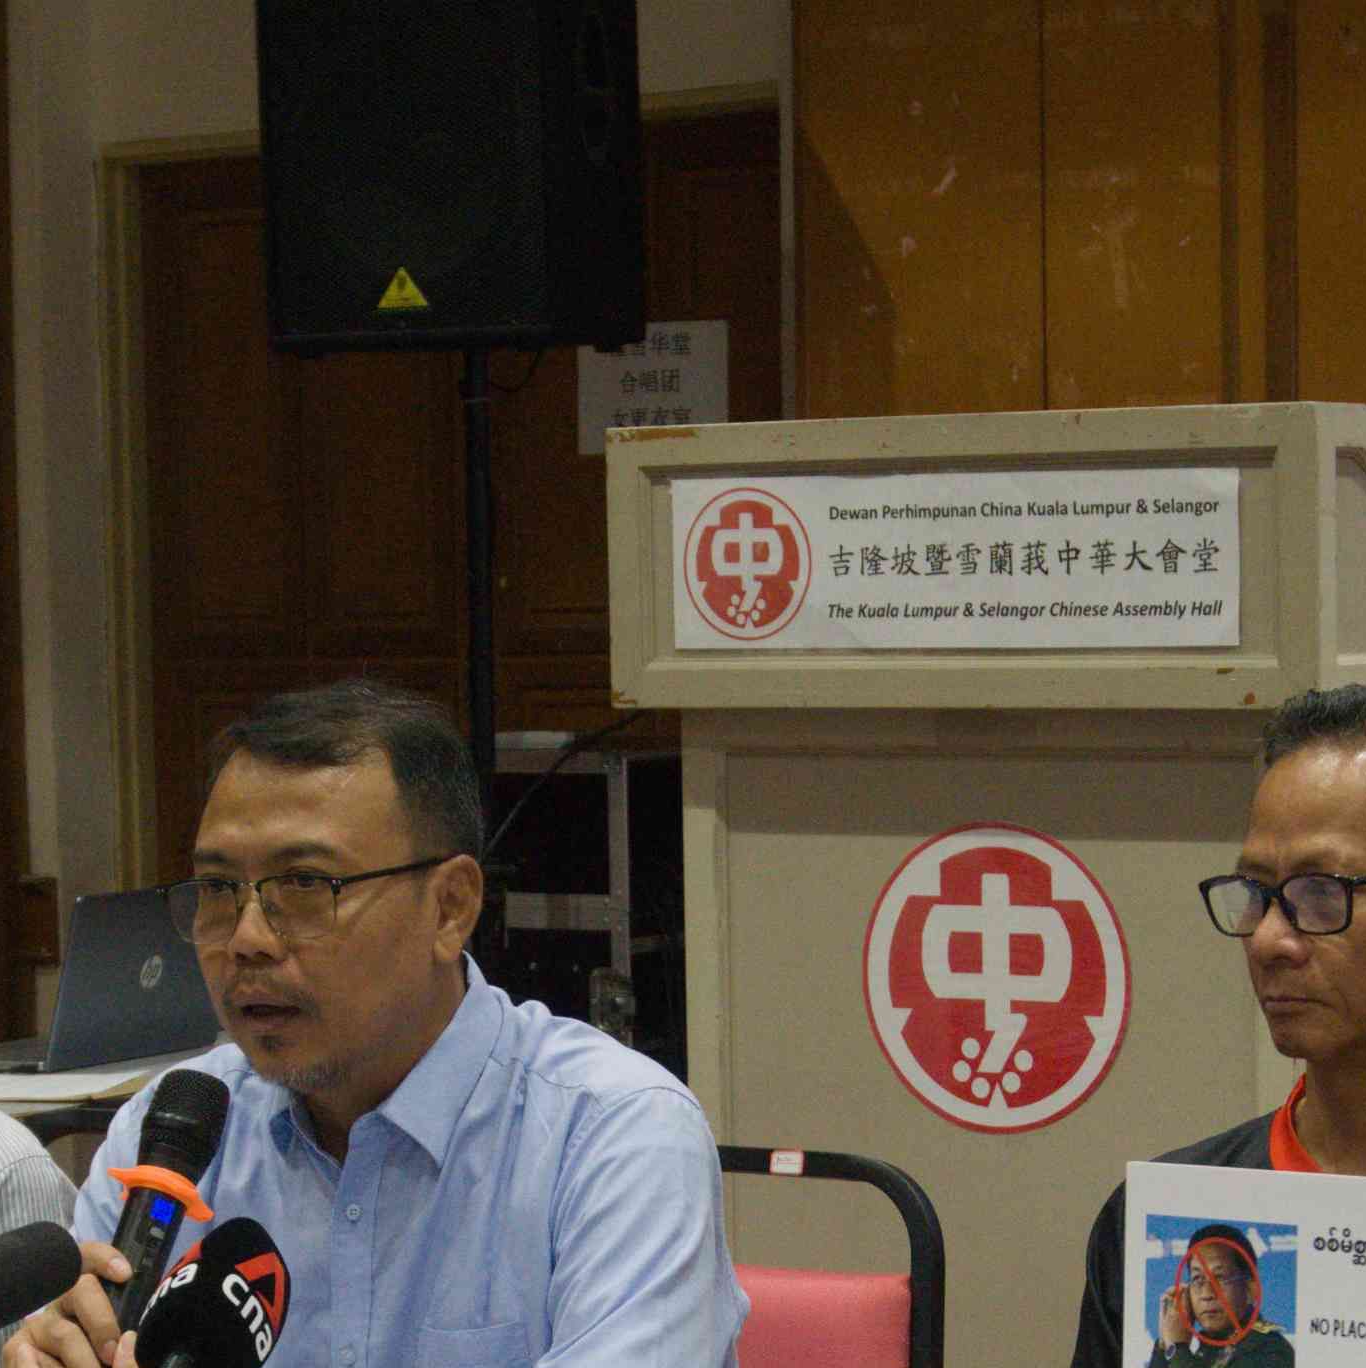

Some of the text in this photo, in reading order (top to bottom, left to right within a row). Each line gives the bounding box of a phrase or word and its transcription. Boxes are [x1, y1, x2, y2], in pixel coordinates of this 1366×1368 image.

[829, 497, 1221, 522] Dewan Perhimpunan China Kuala Lumpur & Selangor
[828, 536, 1221, 577] 吉隆坡暨雪蘭莪中華大會堂
[827, 599, 1223, 622] The Kuala Lumpur & Selangor Chinese Assembly Hall
[222, 1273, 273, 1362] cna
[1310, 1318, 1330, 1336] NO
